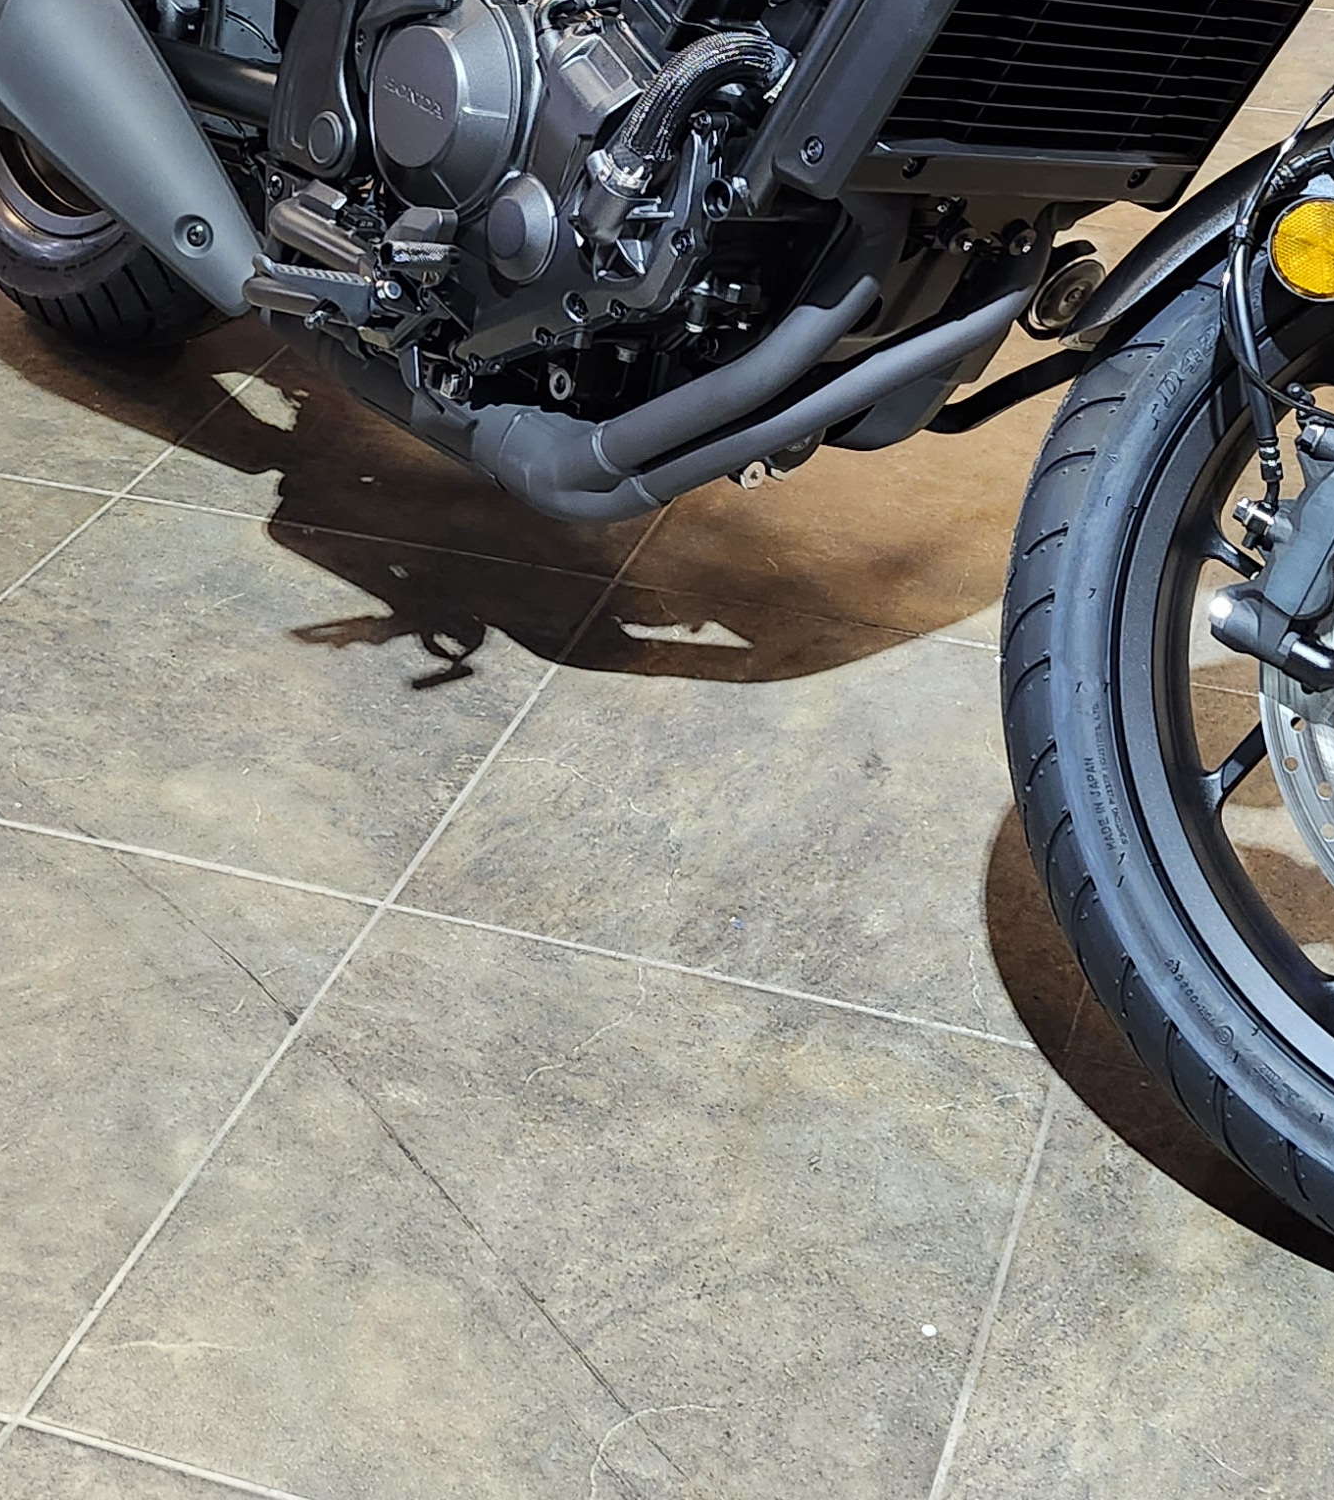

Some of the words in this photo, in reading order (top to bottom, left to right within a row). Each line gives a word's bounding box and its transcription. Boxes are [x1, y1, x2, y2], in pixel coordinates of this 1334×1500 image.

[1083, 756, 1102, 798] JAPAN
[1094, 801, 1107, 814] IN
[1098, 817, 1117, 851] MADE
